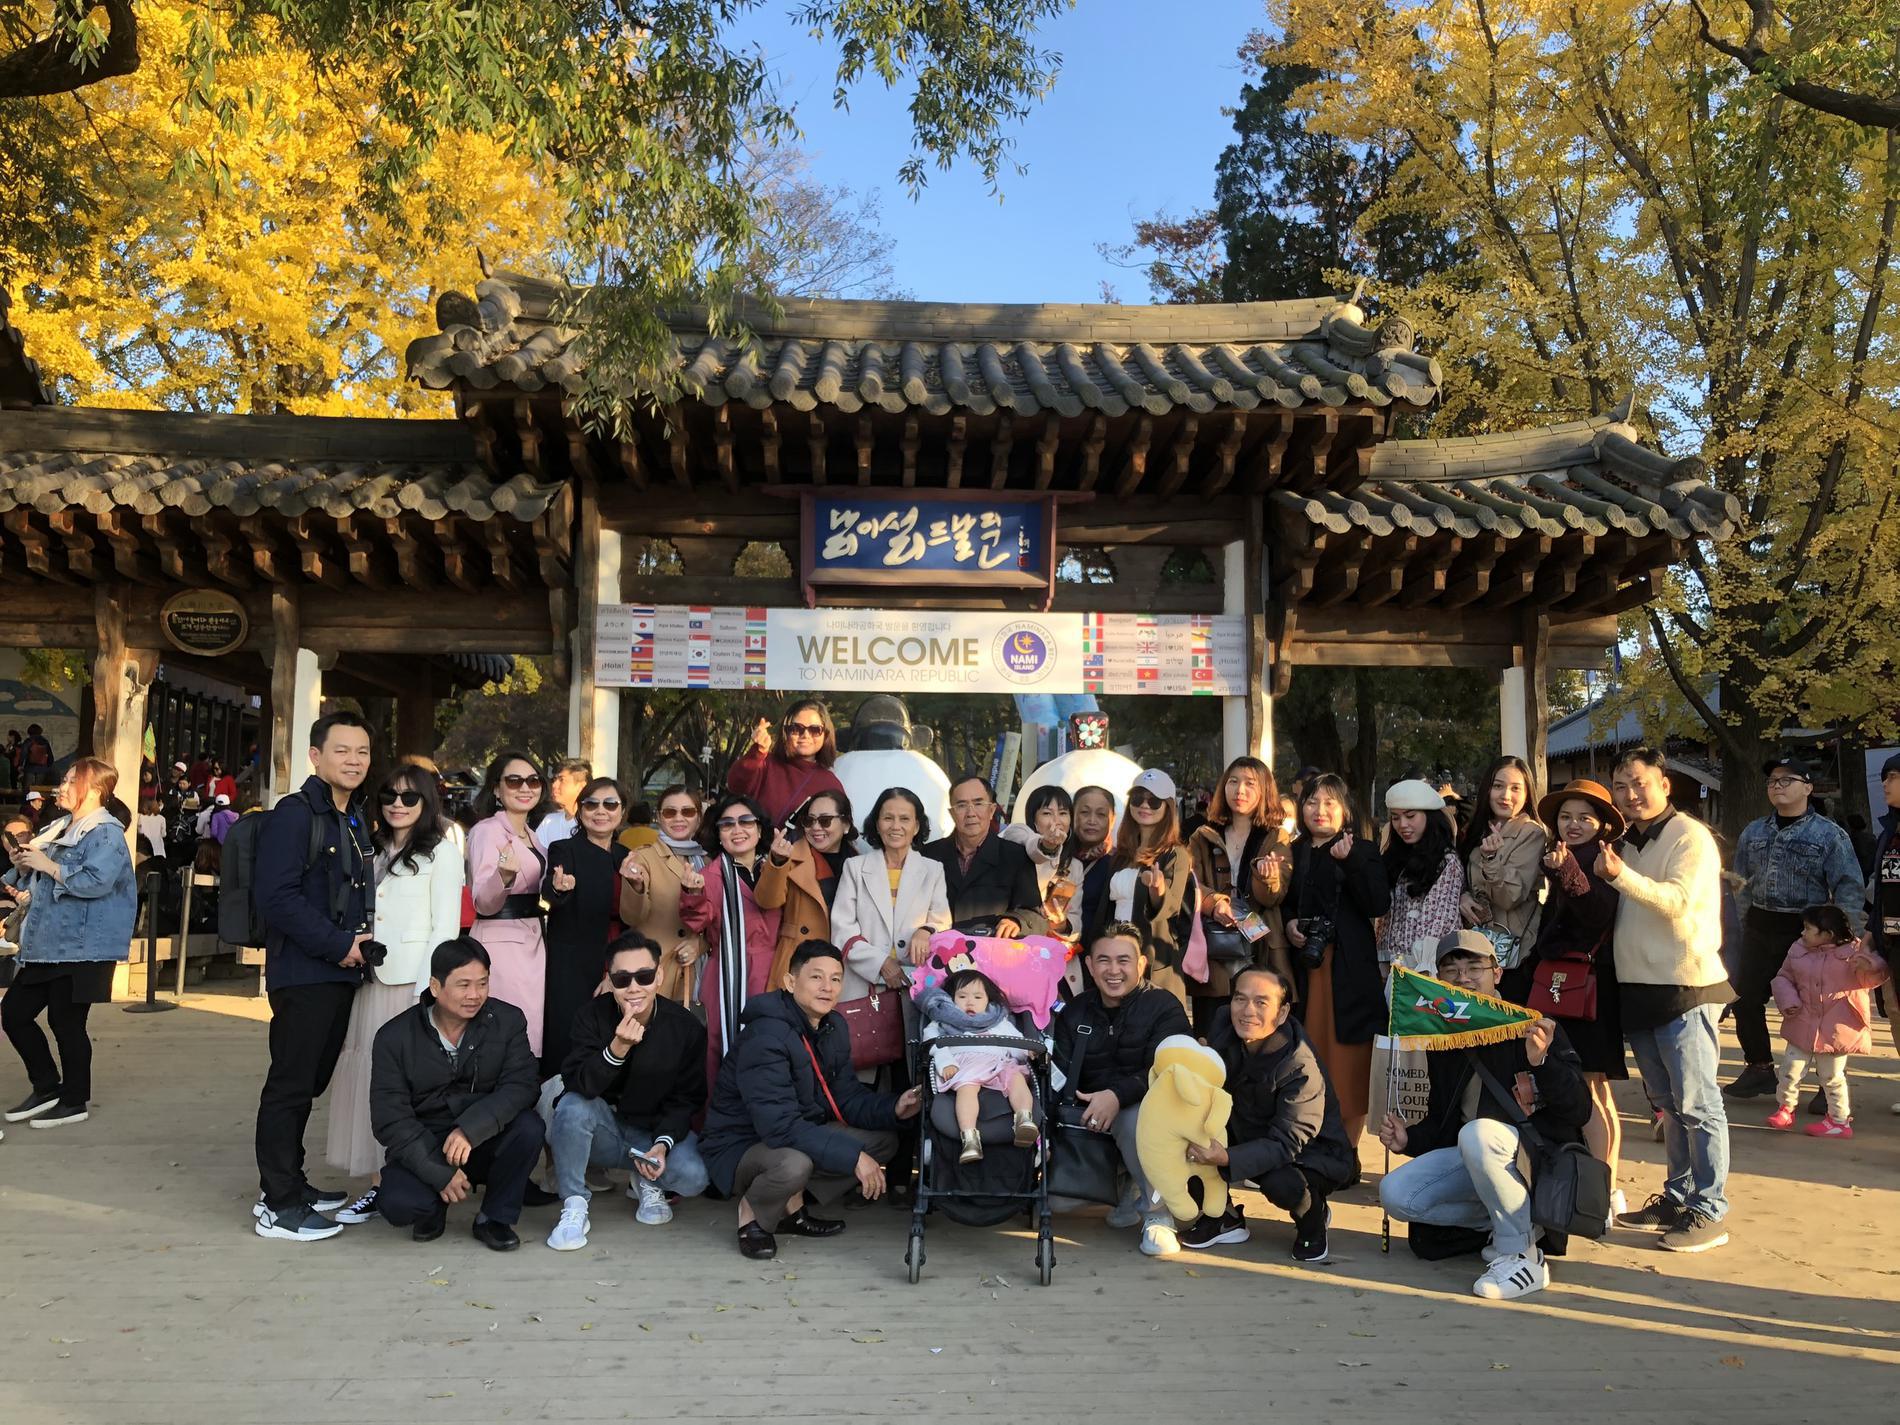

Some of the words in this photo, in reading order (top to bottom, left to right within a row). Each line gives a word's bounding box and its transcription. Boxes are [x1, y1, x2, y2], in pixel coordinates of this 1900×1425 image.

[796, 635, 979, 666] WELCOME
[1010, 654, 1038, 665] NAMI
[601, 662, 624, 670] ¡Hola!
[799, 667, 817, 681] TO
[821, 668, 906, 682] NAMINARA
[911, 669, 980, 683] REPUBLIC
[1414, 1082, 1430, 1093] BE
